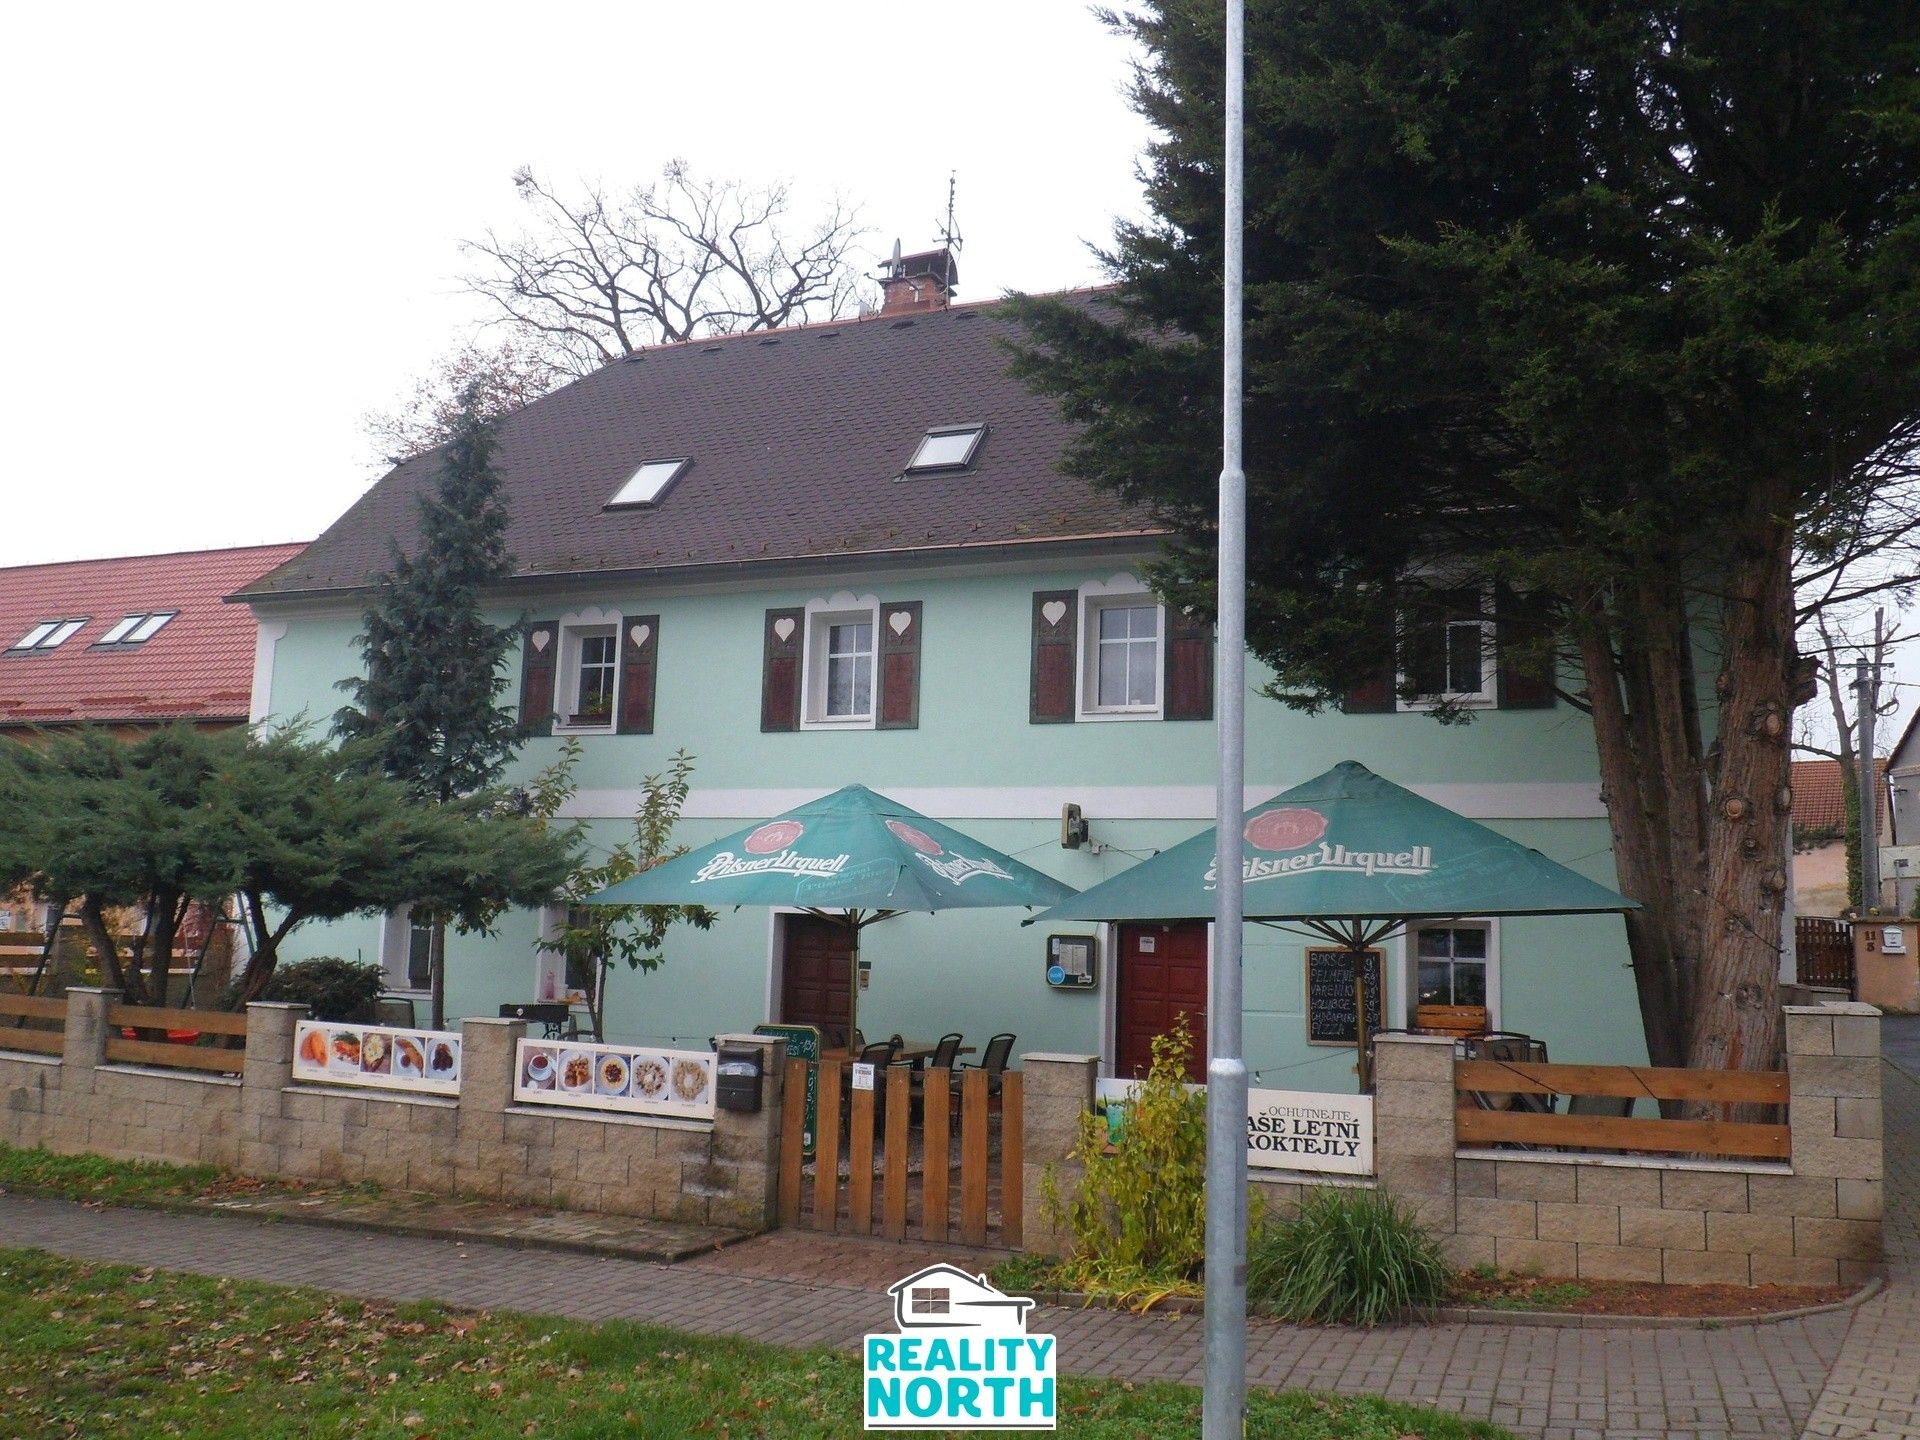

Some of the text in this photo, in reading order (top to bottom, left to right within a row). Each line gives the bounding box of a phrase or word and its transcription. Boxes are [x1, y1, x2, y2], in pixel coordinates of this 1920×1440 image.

[690, 852, 778, 884] Pilsner
[776, 850, 850, 878] Urquell
[1318, 842, 1432, 877] Urquell
[1247, 1112, 1361, 1140] AŠE LETNÍ
[1268, 1106, 1351, 1121] OCHUTNEJTE
